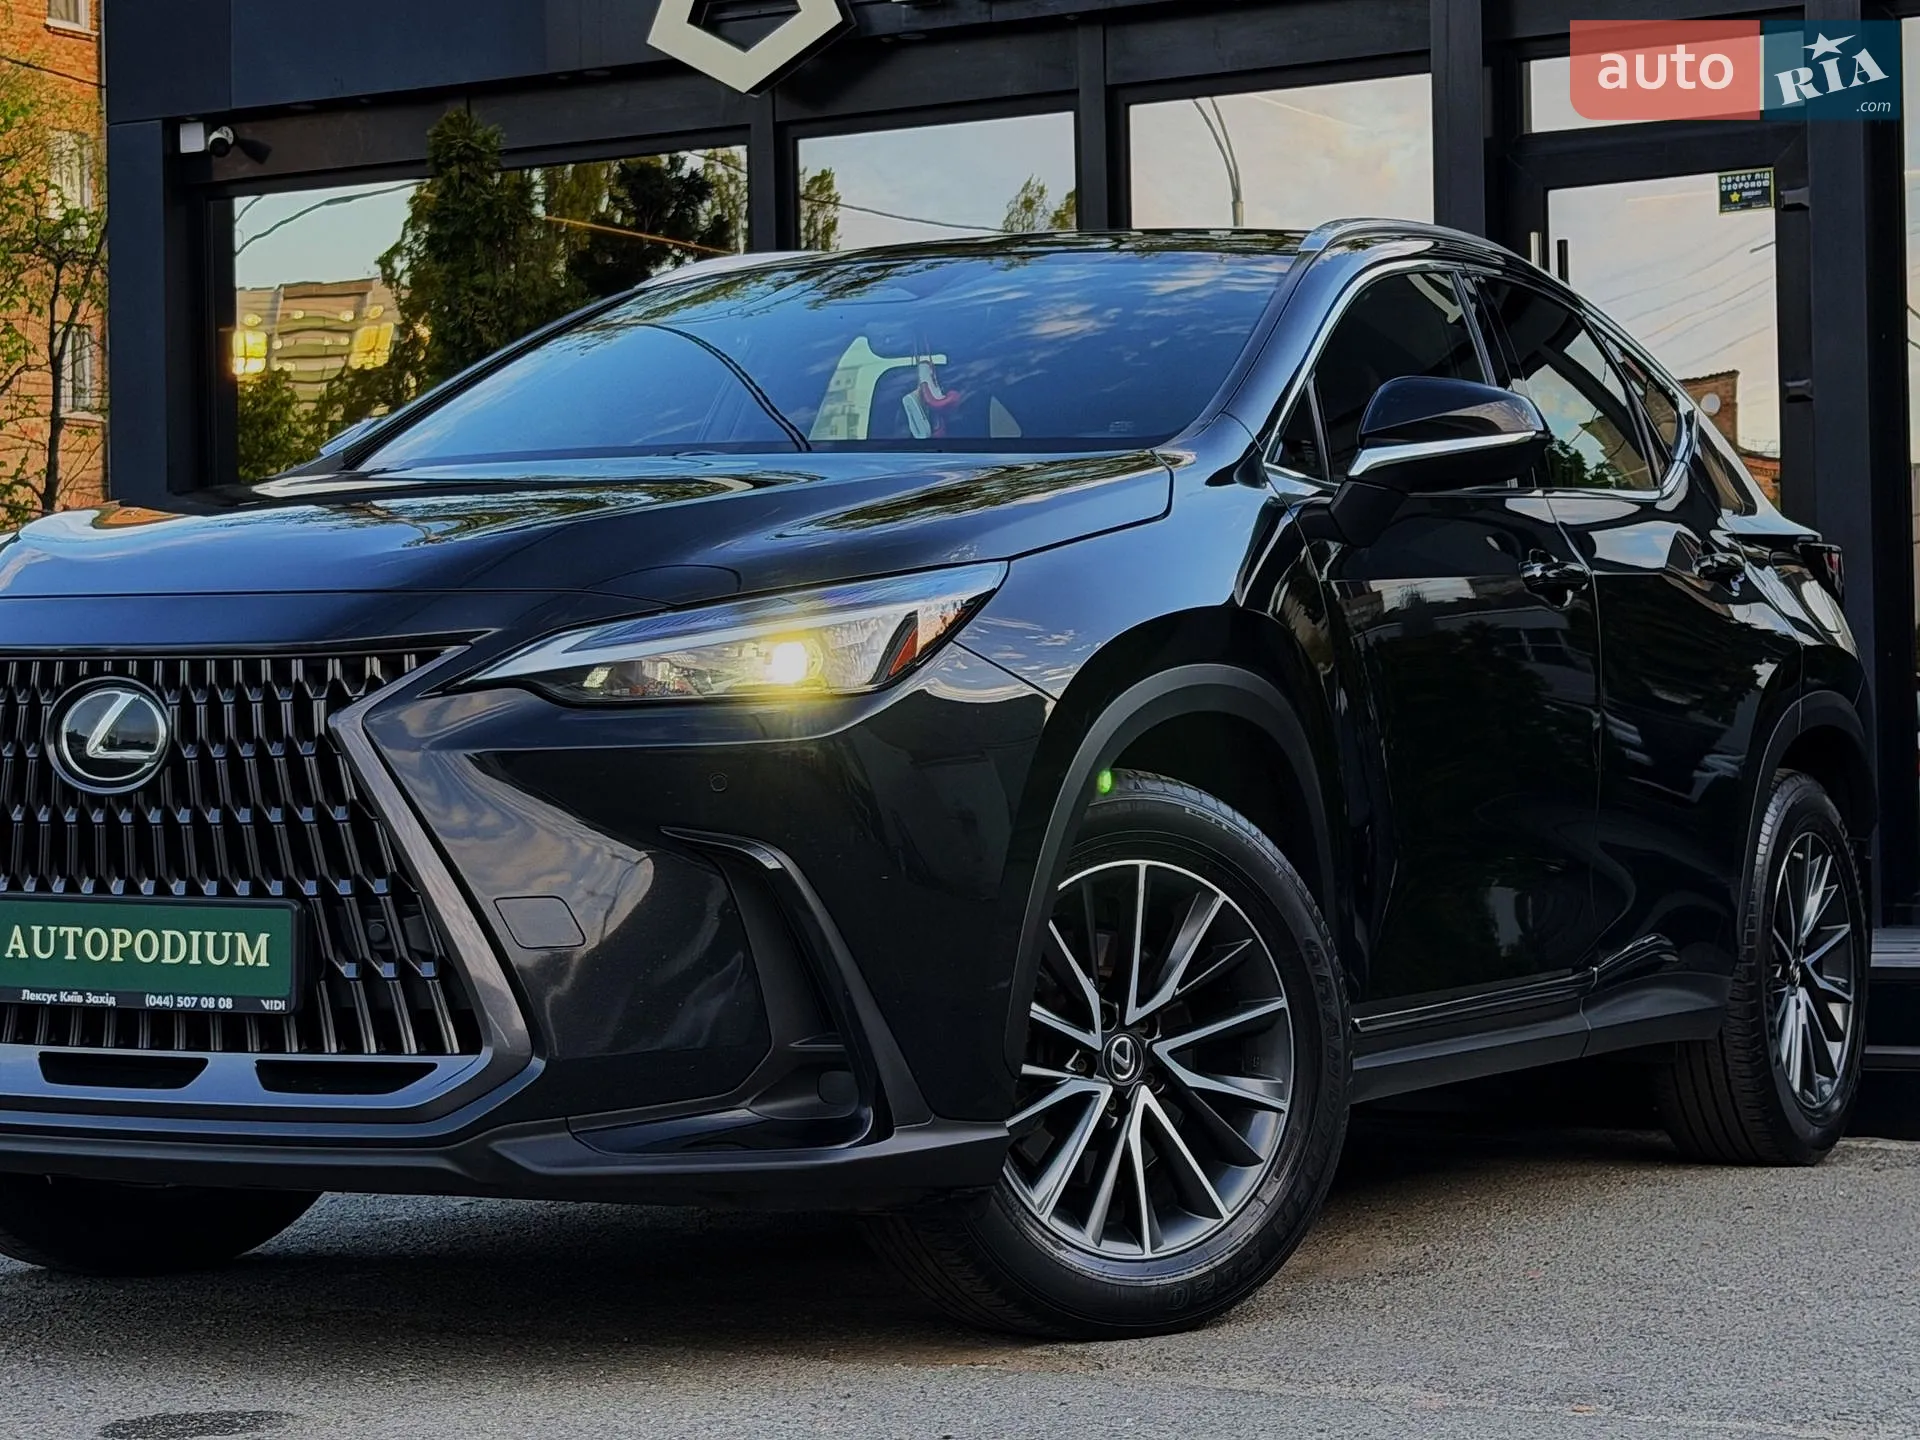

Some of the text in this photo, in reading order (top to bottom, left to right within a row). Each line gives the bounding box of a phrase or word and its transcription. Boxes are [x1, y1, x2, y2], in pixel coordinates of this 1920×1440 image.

[5, 924, 271, 967] AUTOPODIUM
[21, 989, 116, 1006] Лексус Київ Захід
[145, 993, 233, 1009] (044) 507 08 08
[260, 999, 286, 1011] VIDI
